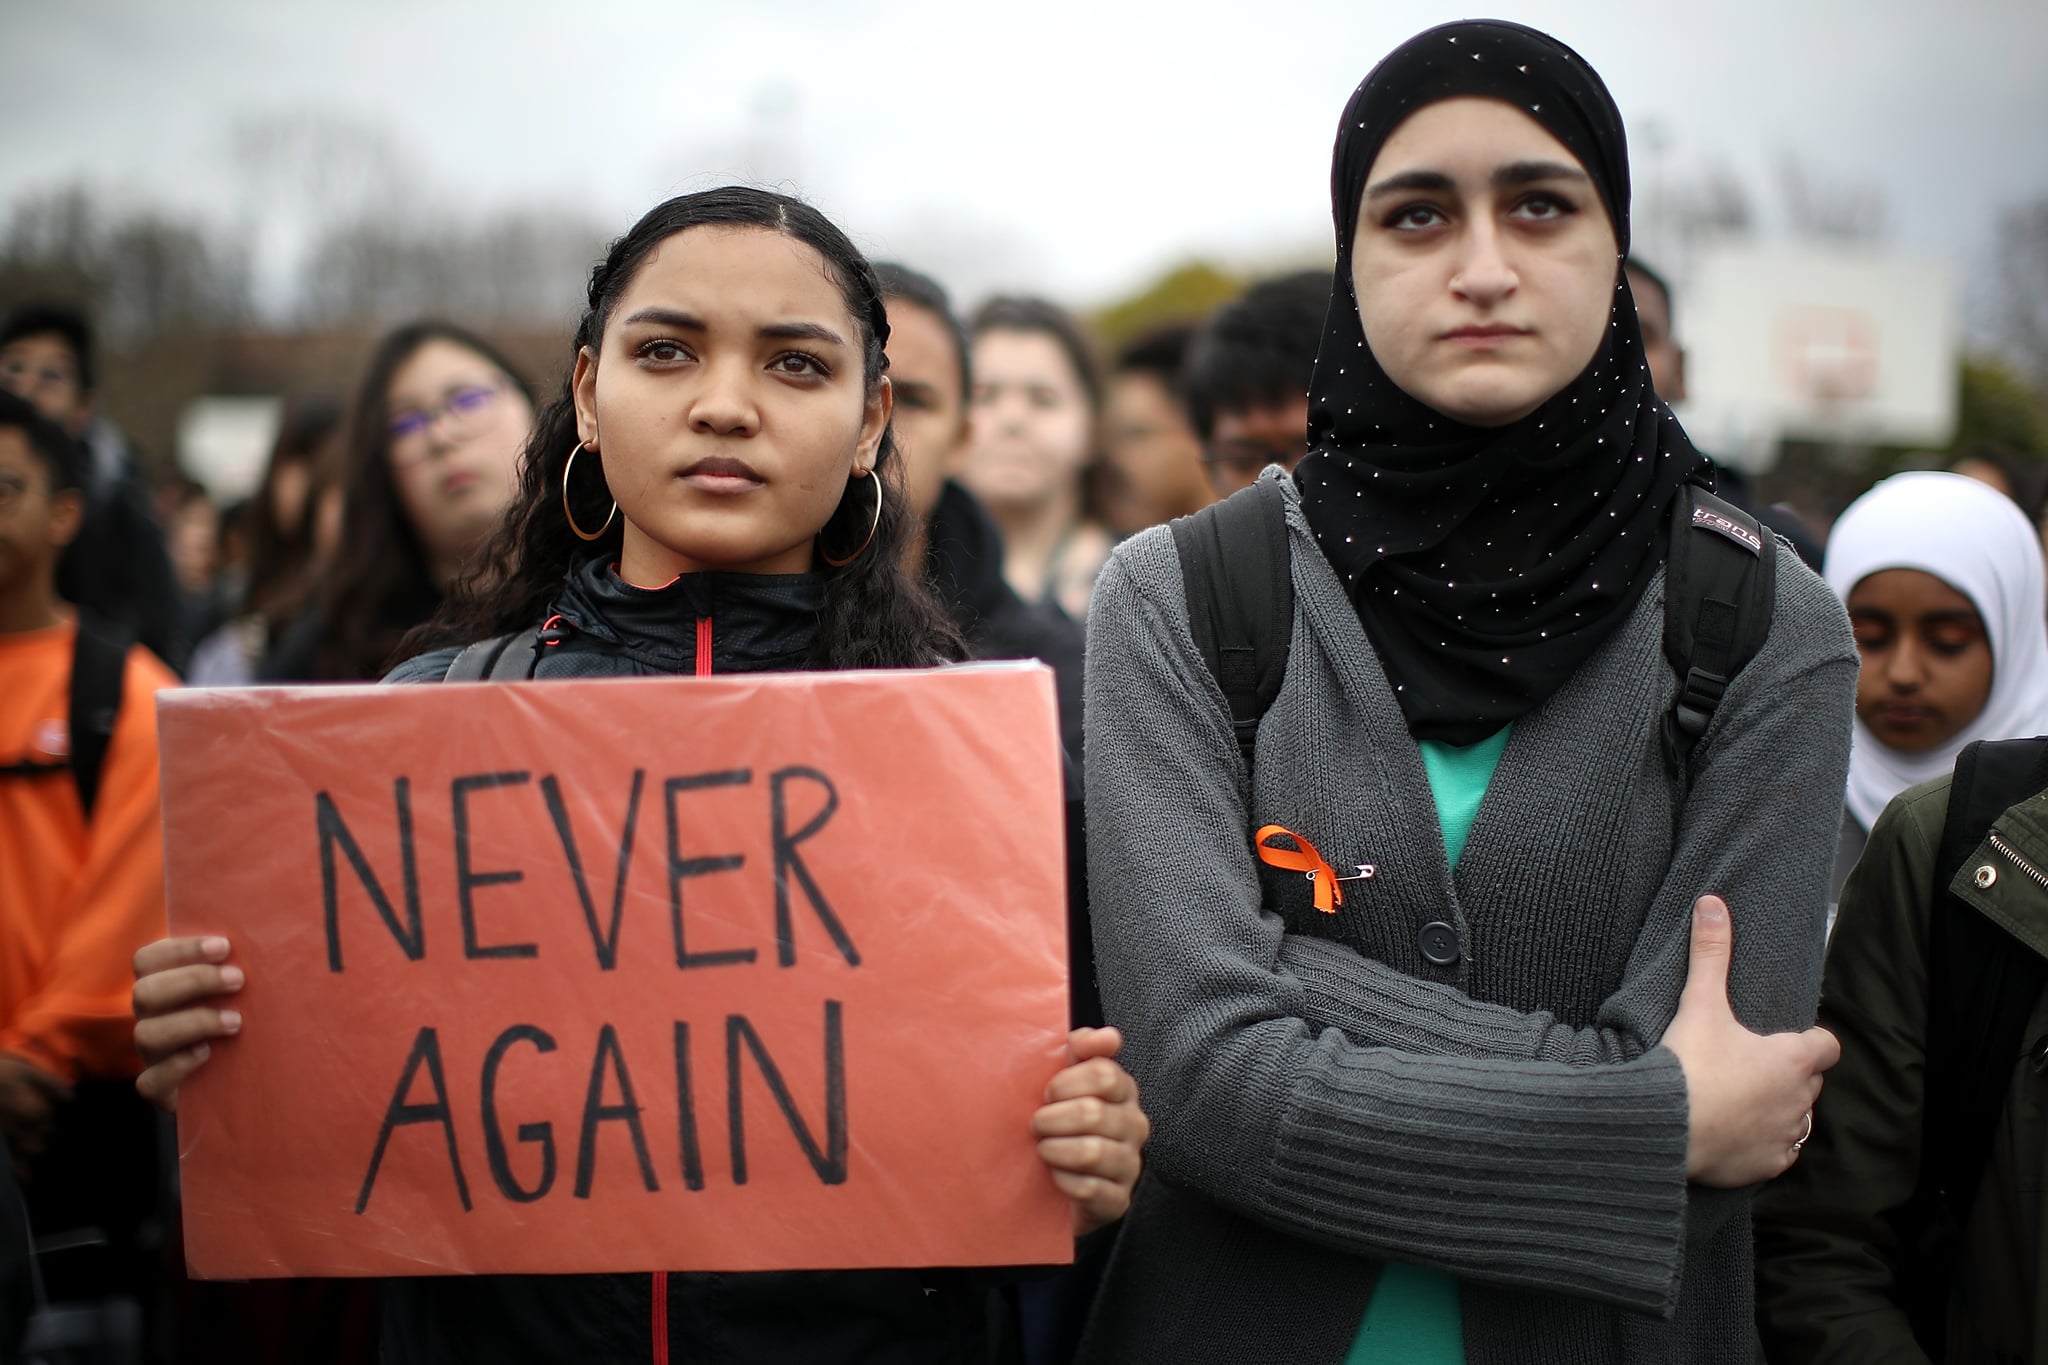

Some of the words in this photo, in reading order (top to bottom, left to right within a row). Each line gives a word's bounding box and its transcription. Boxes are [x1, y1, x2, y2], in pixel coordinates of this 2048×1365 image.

[1693, 508, 1761, 550] trans
[315, 765, 862, 972] NEVER
[355, 1000, 849, 1215] AGAIN
